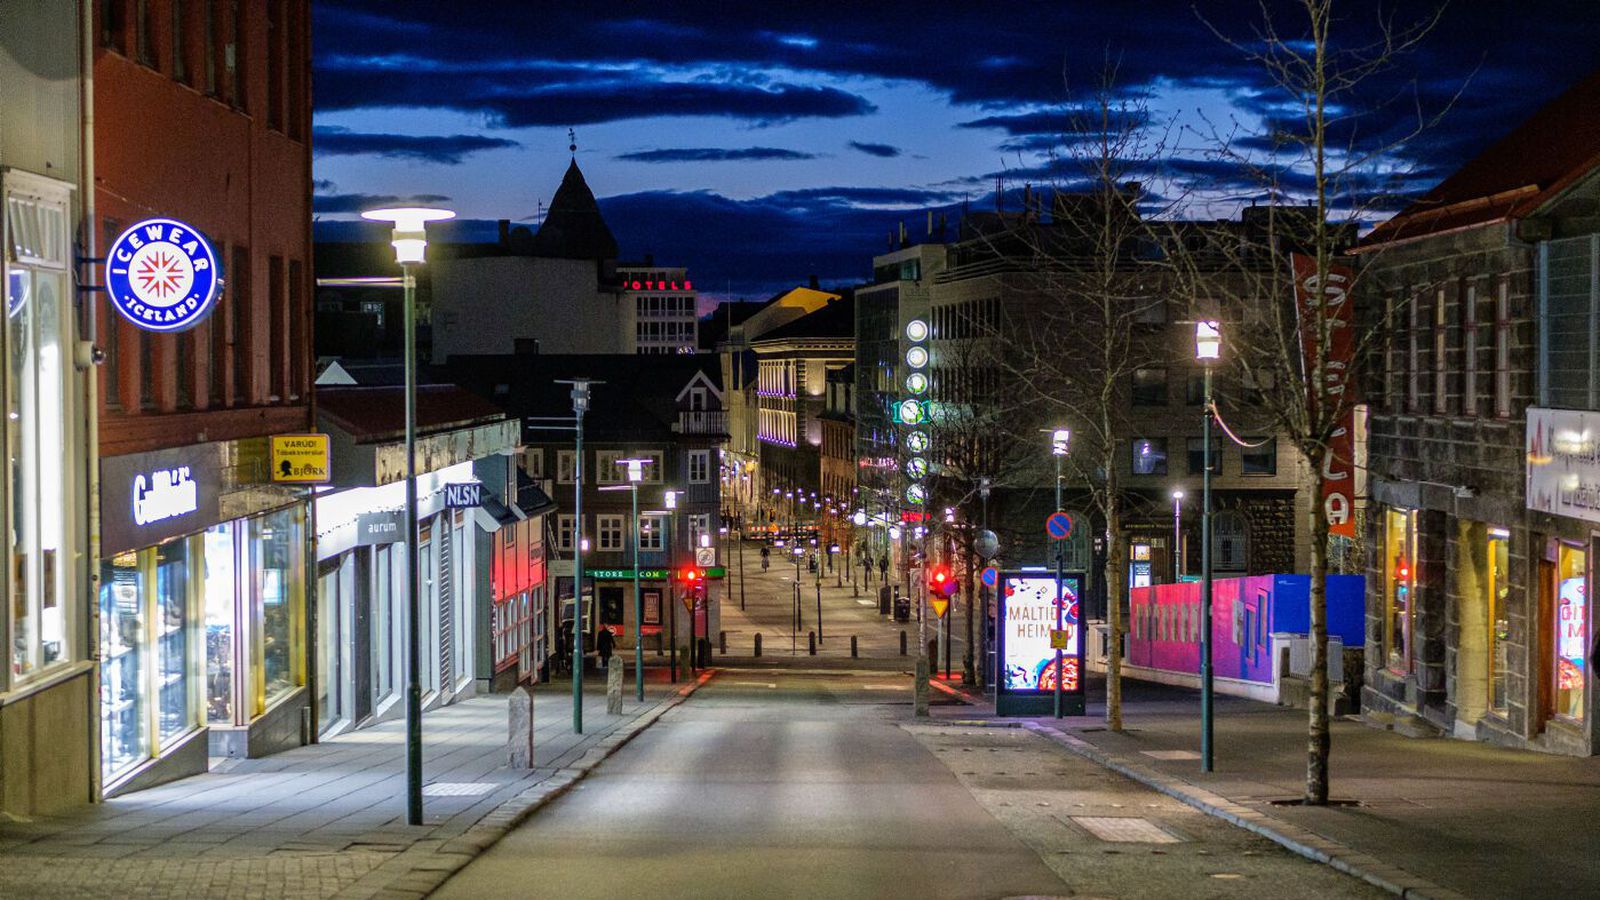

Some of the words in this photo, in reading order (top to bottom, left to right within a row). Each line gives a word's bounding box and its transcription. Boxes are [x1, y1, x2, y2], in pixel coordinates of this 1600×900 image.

[112, 224, 210, 274] ICEWEAR
[125, 297, 198, 322] ICELAND
[1302, 273, 1350, 526] STELA
[446, 485, 480, 506] NLSN
[367, 522, 397, 534] aurum
